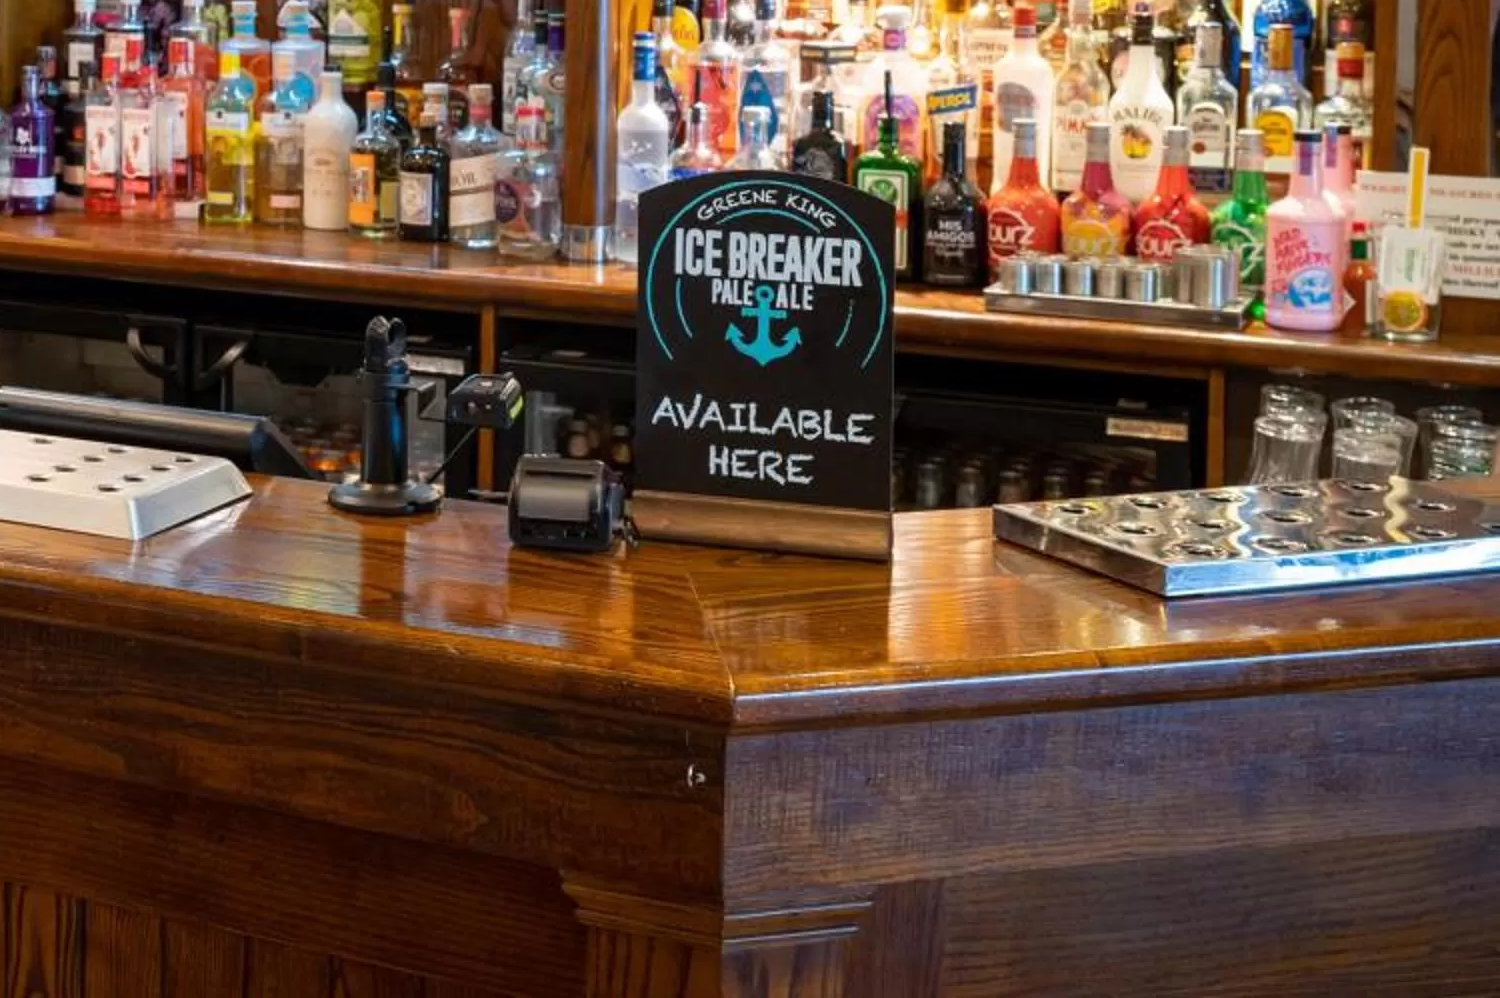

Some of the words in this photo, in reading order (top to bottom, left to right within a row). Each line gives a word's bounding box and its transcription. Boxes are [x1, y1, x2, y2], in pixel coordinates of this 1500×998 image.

[696, 189, 778, 222] GREENE
[785, 192, 836, 229] KING
[674, 227, 724, 278] ICE
[728, 230, 863, 288] BREAKER
[711, 277, 753, 307] PALE
[775, 283, 814, 311] ALE
[651, 393, 876, 445] AVAILABLE
[708, 444, 814, 486] HERE
